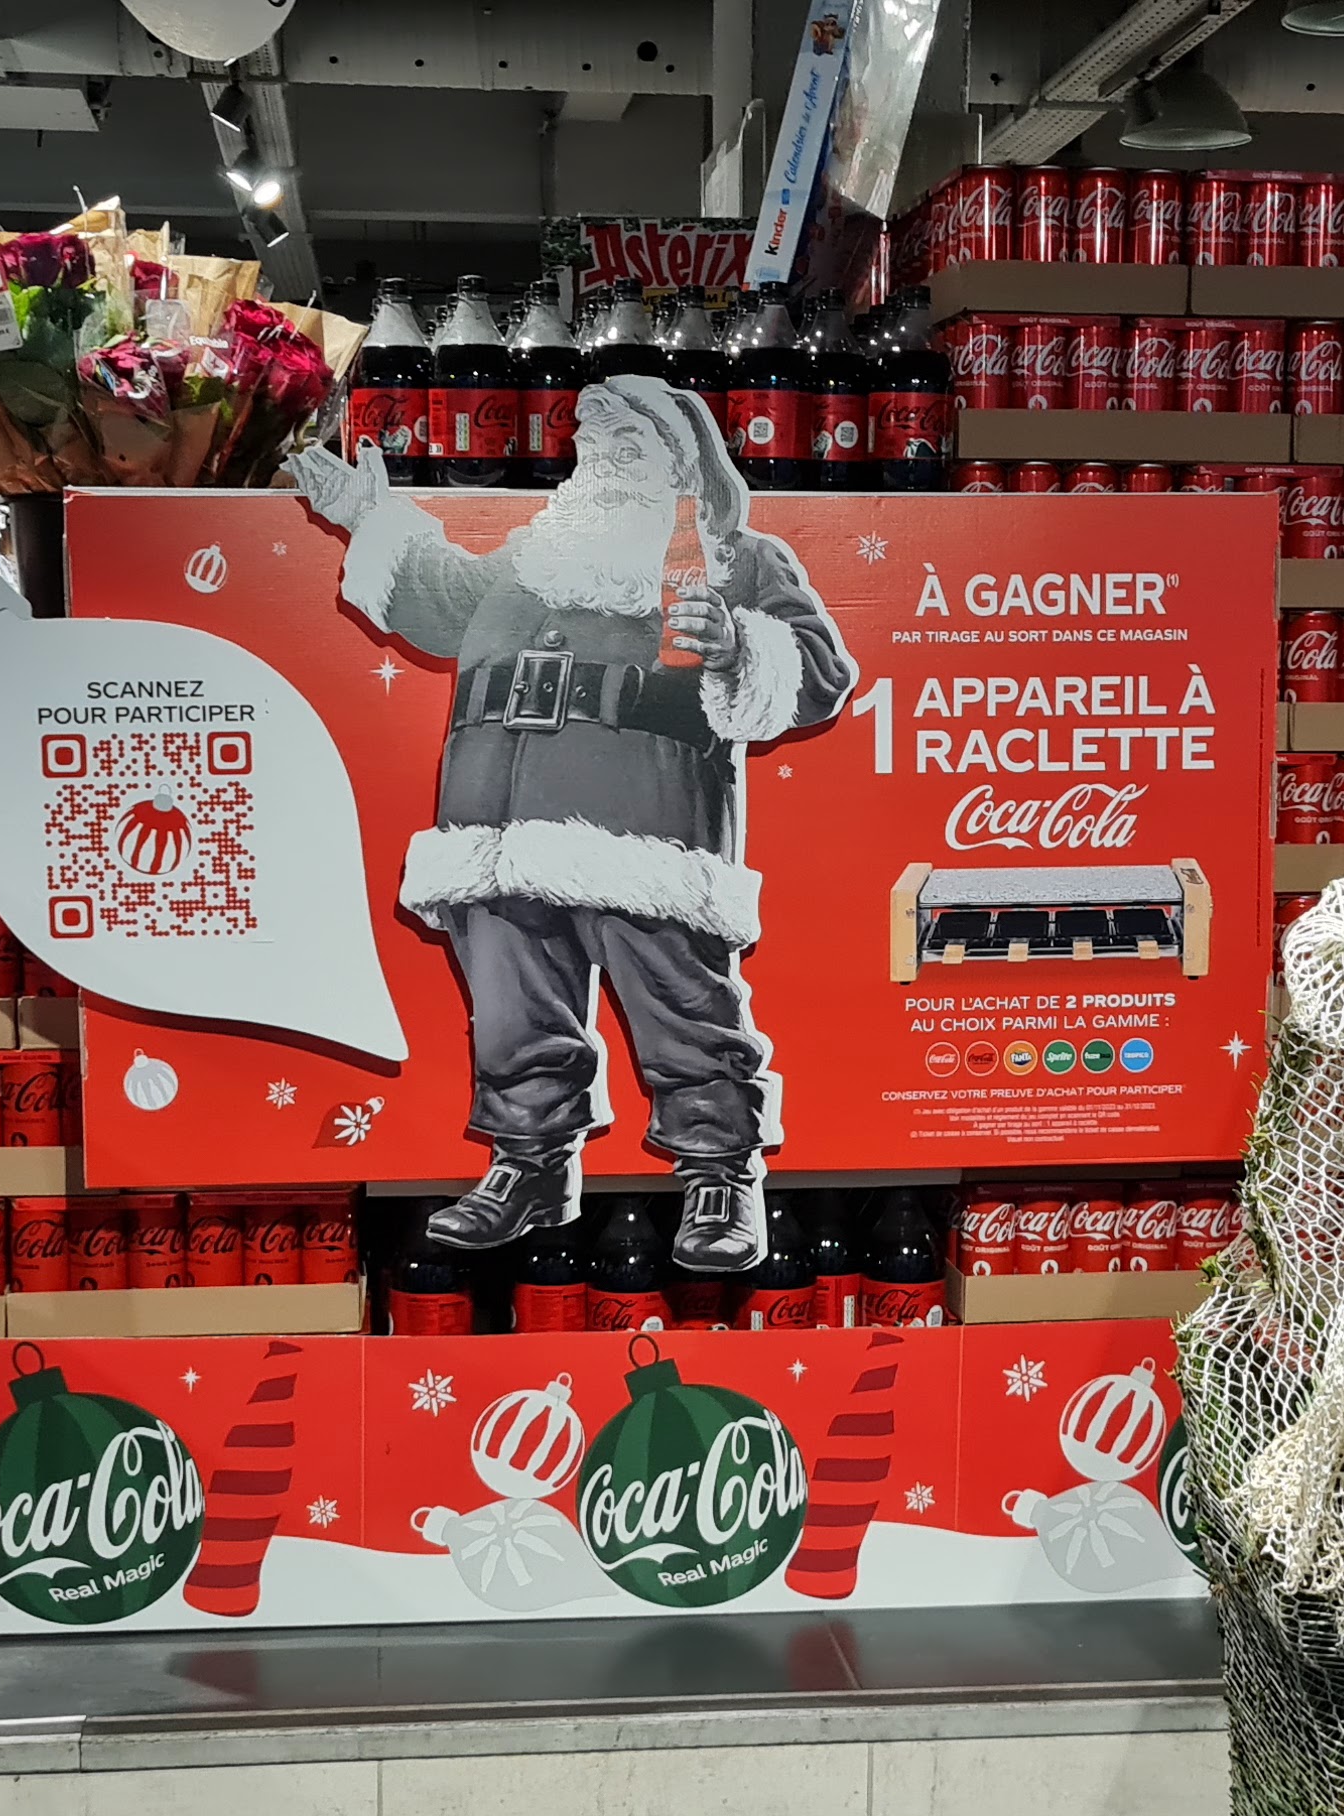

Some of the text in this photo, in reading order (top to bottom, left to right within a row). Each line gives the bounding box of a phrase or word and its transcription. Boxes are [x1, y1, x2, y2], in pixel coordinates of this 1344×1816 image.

[915, 562, 951, 617] À
[892, 628, 1188, 645] PAR TIRAGE AU SORT DANS CE MAGASIN
[37, 703, 256, 726] POUR PARTICIPER
[86, 680, 205, 700] SCANNEZ
[913, 663, 1216, 718] APPAREIL À
[851, 677, 893, 774] 1
[916, 725, 1216, 774] RACLETTE
[944, 783, 1150, 851] Coca-Cola
[905, 992, 1177, 1013] POUR L'ACHAT DE 2 PRODUITS
[910, 1018, 936, 1032] AU
[940, 1017, 997, 1031] CHOIX
[1002, 1016, 1057, 1030] PARMI
[1063, 1015, 1087, 1029] LA
[1092, 1013, 1160, 1028] GAMME
[881, 1084, 1183, 1102] CONSERVEZ VOTRE PREUVE D'ACHAT POUR PARTICIPER
[579, 1408, 808, 1571] Coca-Cola
[48, 1552, 166, 1605] Real Magic
[657, 1538, 770, 1589] Real Magic
